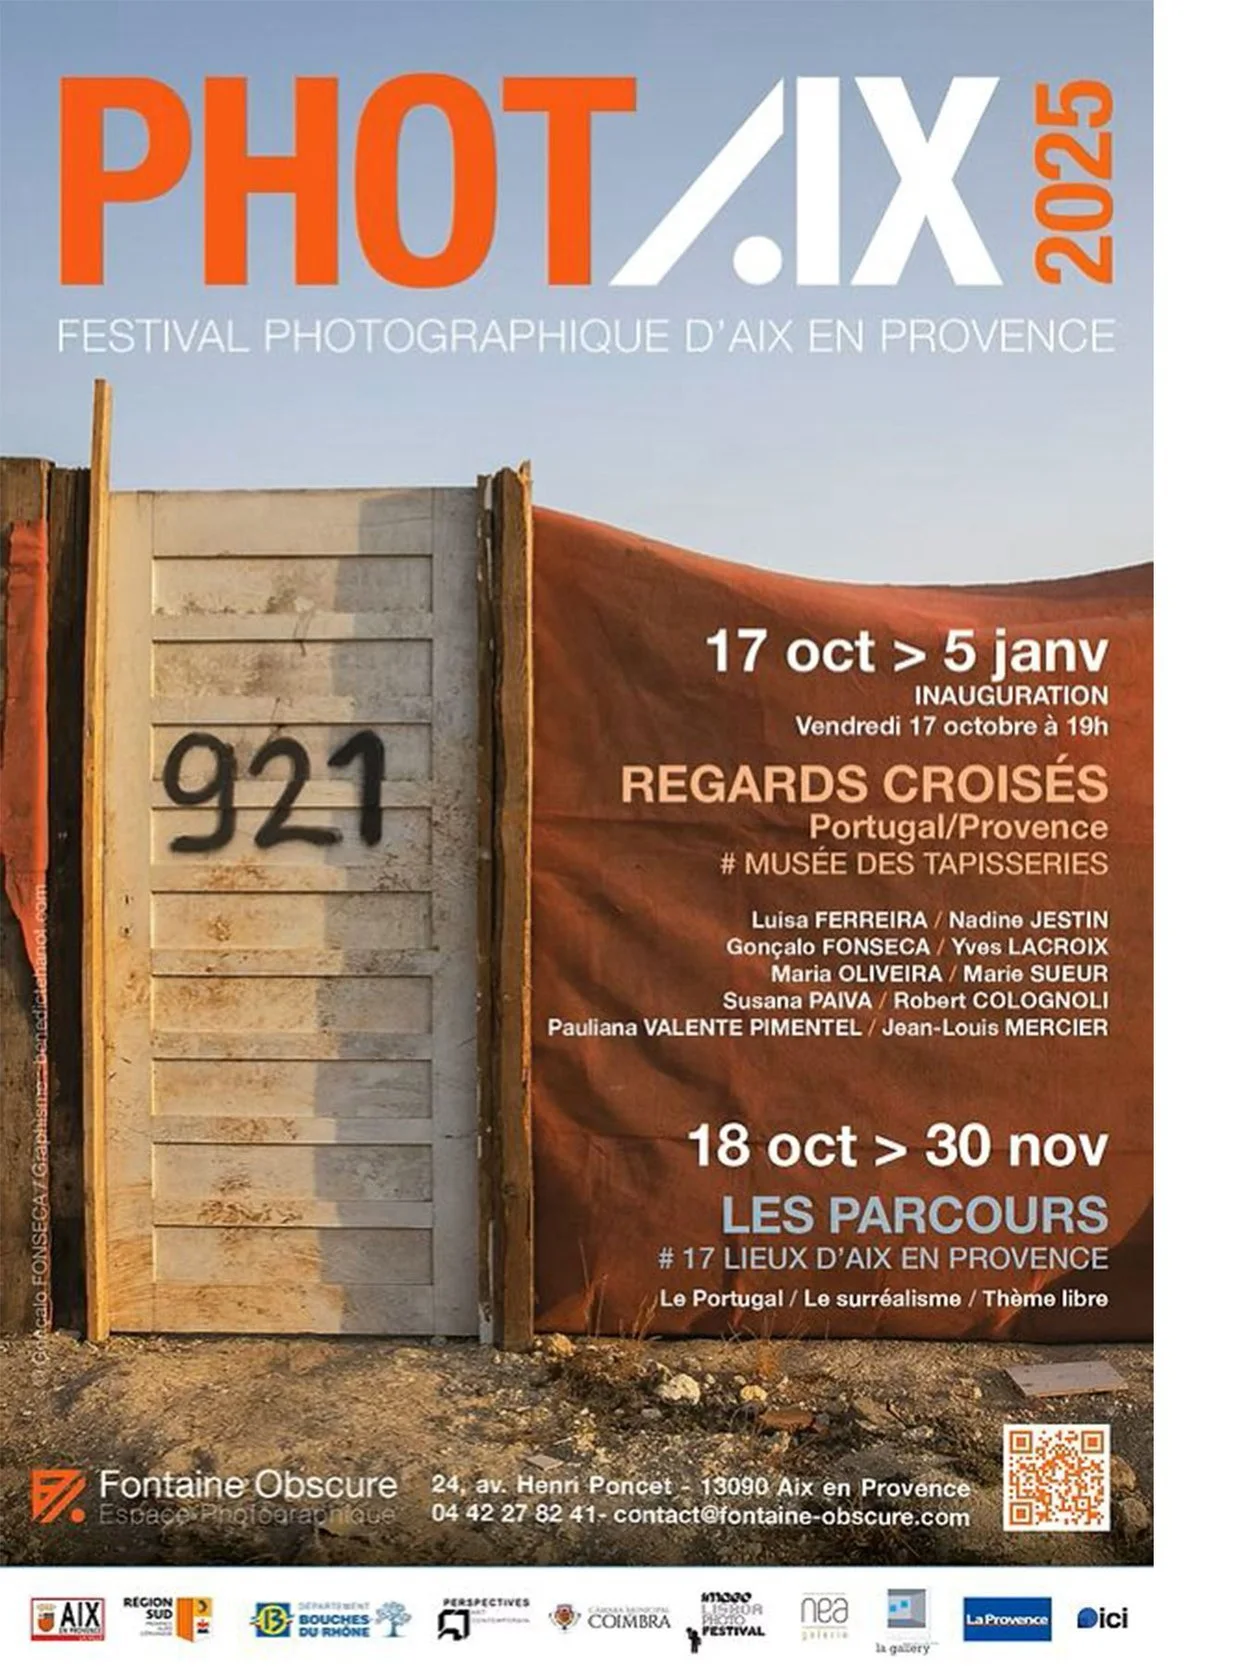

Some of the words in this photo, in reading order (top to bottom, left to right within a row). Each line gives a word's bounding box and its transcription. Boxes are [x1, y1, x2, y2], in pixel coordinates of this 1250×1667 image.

[1035, 79, 1113, 285] 2025
[59, 316, 249, 354] FESTIVAL
[266, 316, 669, 354] PHOTOGRAPHIQUE
[810, 316, 864, 354] EN
[882, 316, 1115, 354] PROVENCE
[706, 629, 767, 673] 17
[787, 629, 875, 673] oct
[945, 629, 976, 673] 5
[993, 629, 1109, 681] janv
[915, 686, 1109, 706] INAUGURATION
[797, 717, 901, 737] Vendredi
[911, 717, 936, 737] 17
[944, 717, 1038, 737] octobre
[1045, 716, 1059, 737] à
[1067, 717, 1109, 737] 19h
[622, 765, 868, 804] REGARDS
[884, 754, 1109, 804] CROISÉS
[163, 729, 385, 853] 921
[810, 813, 1109, 845] Portugal/Provence
[720, 852, 736, 876] #
[745, 846, 847, 876] MUSÉE
[857, 852, 914, 876] DES
[923, 852, 1109, 876] TAPISSERIES
[752, 911, 808, 930] Luisa
[816, 911, 928, 930] FERREIRA
[949, 911, 1024, 930] Nadine
[1030, 911, 1109, 930] JESTIN
[727, 938, 815, 959] Gonçalo
[823, 938, 930, 955] FONSECA
[952, 938, 1001, 955] Yves
[1009, 938, 1109, 955] LACROIX
[772, 964, 832, 983] Maria
[838, 964, 942, 983] OLIVEIRA
[964, 964, 1023, 983] Marie
[1030, 964, 1109, 983] SUEUR
[723, 991, 802, 1010] Susana
[809, 991, 872, 1010] PAIVA
[894, 991, 966, 1010] Robert
[973, 991, 1109, 1010] COLOGNOLI
[548, 1018, 638, 1037] Pauliana
[643, 1018, 743, 1037] VALENTE
[750, 1018, 862, 1037] PIMENTEL
[882, 1018, 999, 1037] Jean-Louis
[1005, 1018, 1109, 1037] MERCIER
[688, 1123, 749, 1167] 18
[768, 1123, 858, 1167] oct
[926, 1123, 990, 1167] 30
[1010, 1134, 1107, 1167] nov
[722, 1195, 814, 1235] LES
[830, 1195, 1109, 1235] PARCOURS
[32, 1194, 47, 1286] FONSECA
[659, 1247, 673, 1271] #
[684, 1247, 715, 1271] 17
[725, 1247, 807, 1271] LIEUX
[902, 1247, 939, 1271] EN
[950, 1247, 1109, 1271] PROVENCE
[660, 1289, 686, 1308] Le
[693, 1289, 784, 1312] Portugal
[804, 1289, 830, 1308] Le
[836, 1289, 962, 1308] surréalisme
[983, 1289, 1056, 1308] Thème
[1062, 1289, 1109, 1308] libre
[100, 1469, 245, 1499] Fontaine
[255, 1469, 398, 1499] Obscure
[431, 1474, 466, 1497] 24,
[475, 1474, 507, 1497] av.
[517, 1474, 579, 1497] Henri
[589, 1474, 671, 1497] Poncet
[702, 1474, 769, 1497] 13090
[778, 1474, 813, 1497] Aix
[822, 1480, 850, 1497] en
[861, 1474, 970, 1497] Provence
[99, 1503, 192, 1526] Espace
[431, 1504, 458, 1524] 04
[466, 1504, 493, 1524] 42
[501, 1504, 527, 1524] 27
[535, 1504, 562, 1524] 82
[614, 1505, 970, 1528] contact@fontaine-obscure.com
[123, 1596, 173, 1607] RÉGION
[443, 1598, 530, 1607] PERSPECTIVES
[801, 1597, 848, 1623] nea
[60, 1602, 100, 1627] AIX
[146, 1609, 173, 1619] SUD
[587, 1614, 671, 1629] COIMBRA
[702, 1615, 746, 1626] PHOTO
[1099, 1607, 1128, 1628] ici
[299, 1627, 319, 1637] DU
[322, 1624, 370, 1637] RHÔNE
[702, 1626, 765, 1636] FESTIVAL
[876, 1643, 886, 1653] la
